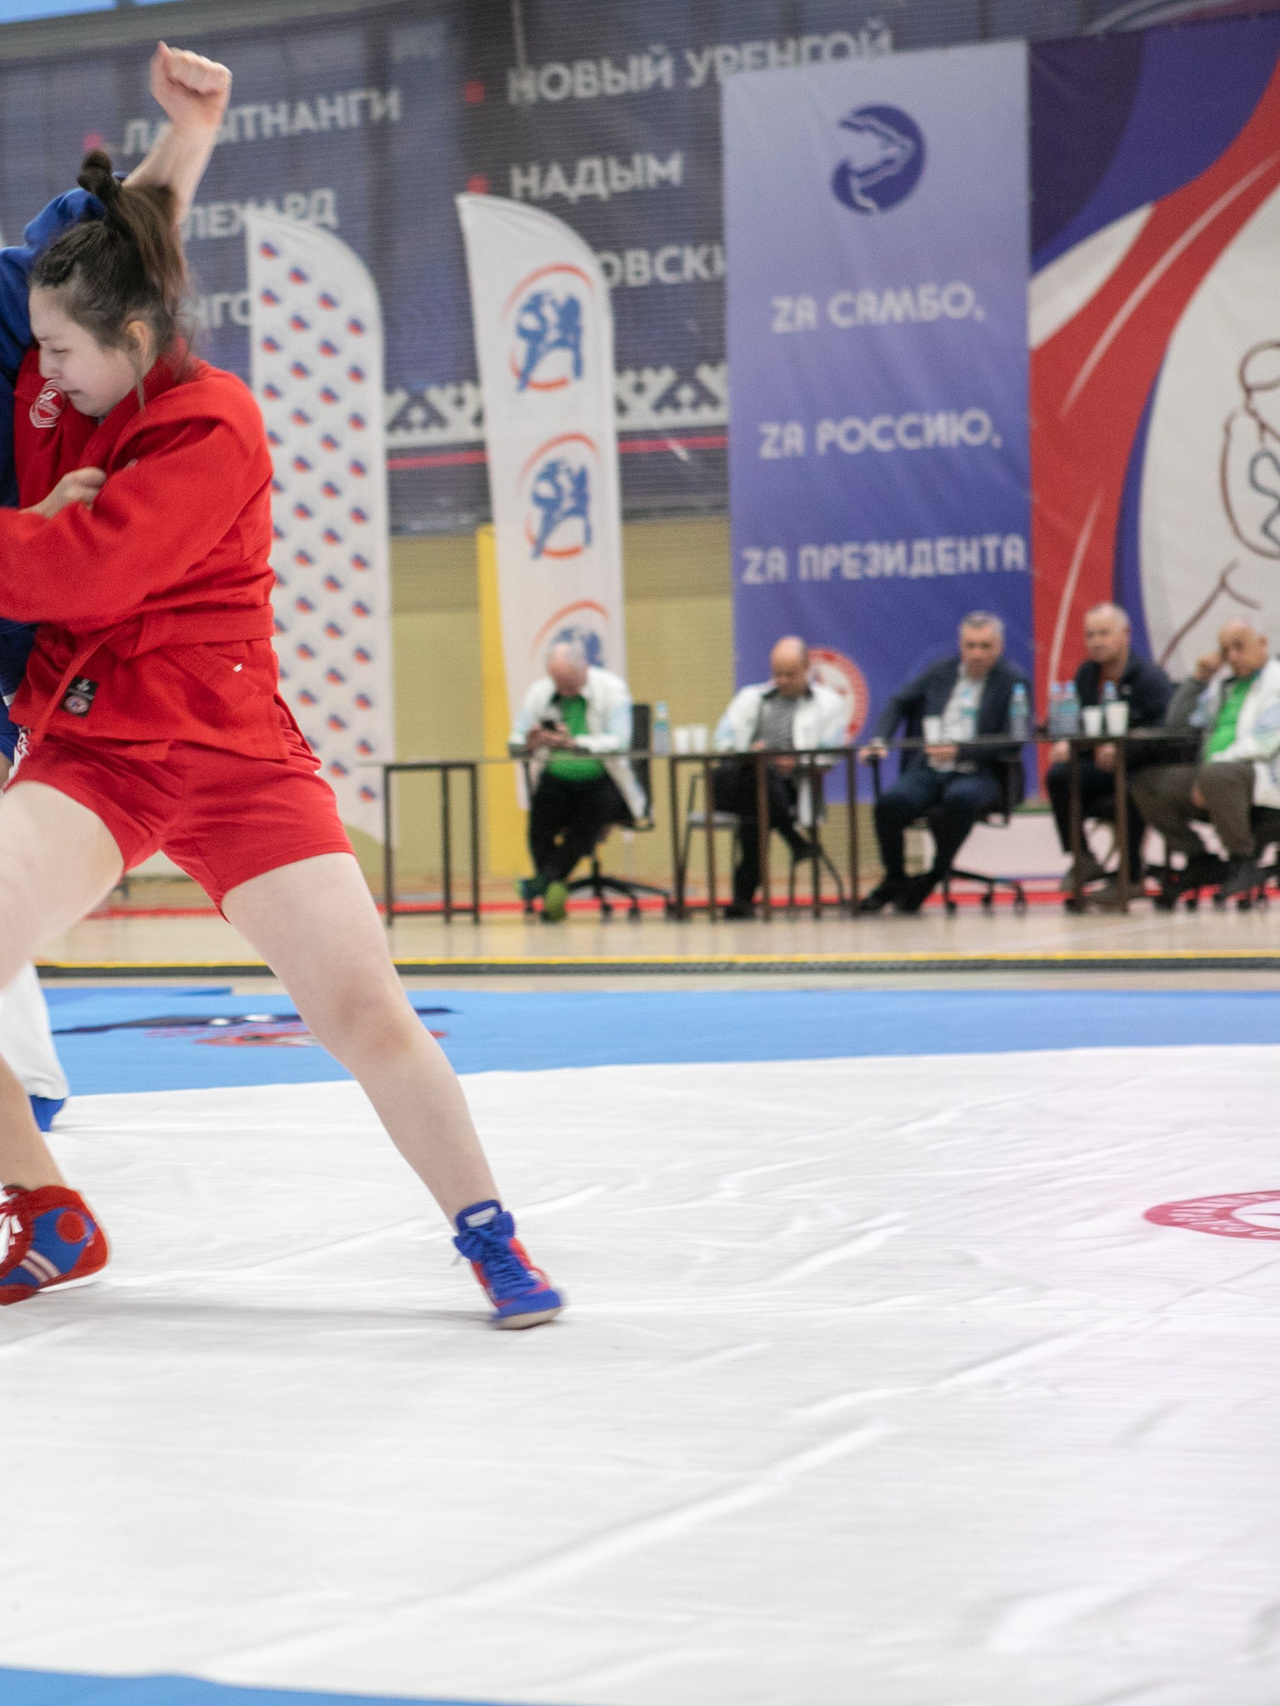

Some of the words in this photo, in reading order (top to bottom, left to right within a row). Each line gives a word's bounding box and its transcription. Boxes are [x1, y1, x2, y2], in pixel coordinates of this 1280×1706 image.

[508, 44, 675, 104] НОВЫЙ
[122, 88, 402, 156] ЛТНАНГИ
[510, 150, 683, 203] НАДЫМ
[798, 532, 1028, 582] ПРЕЗИДЕНТА
